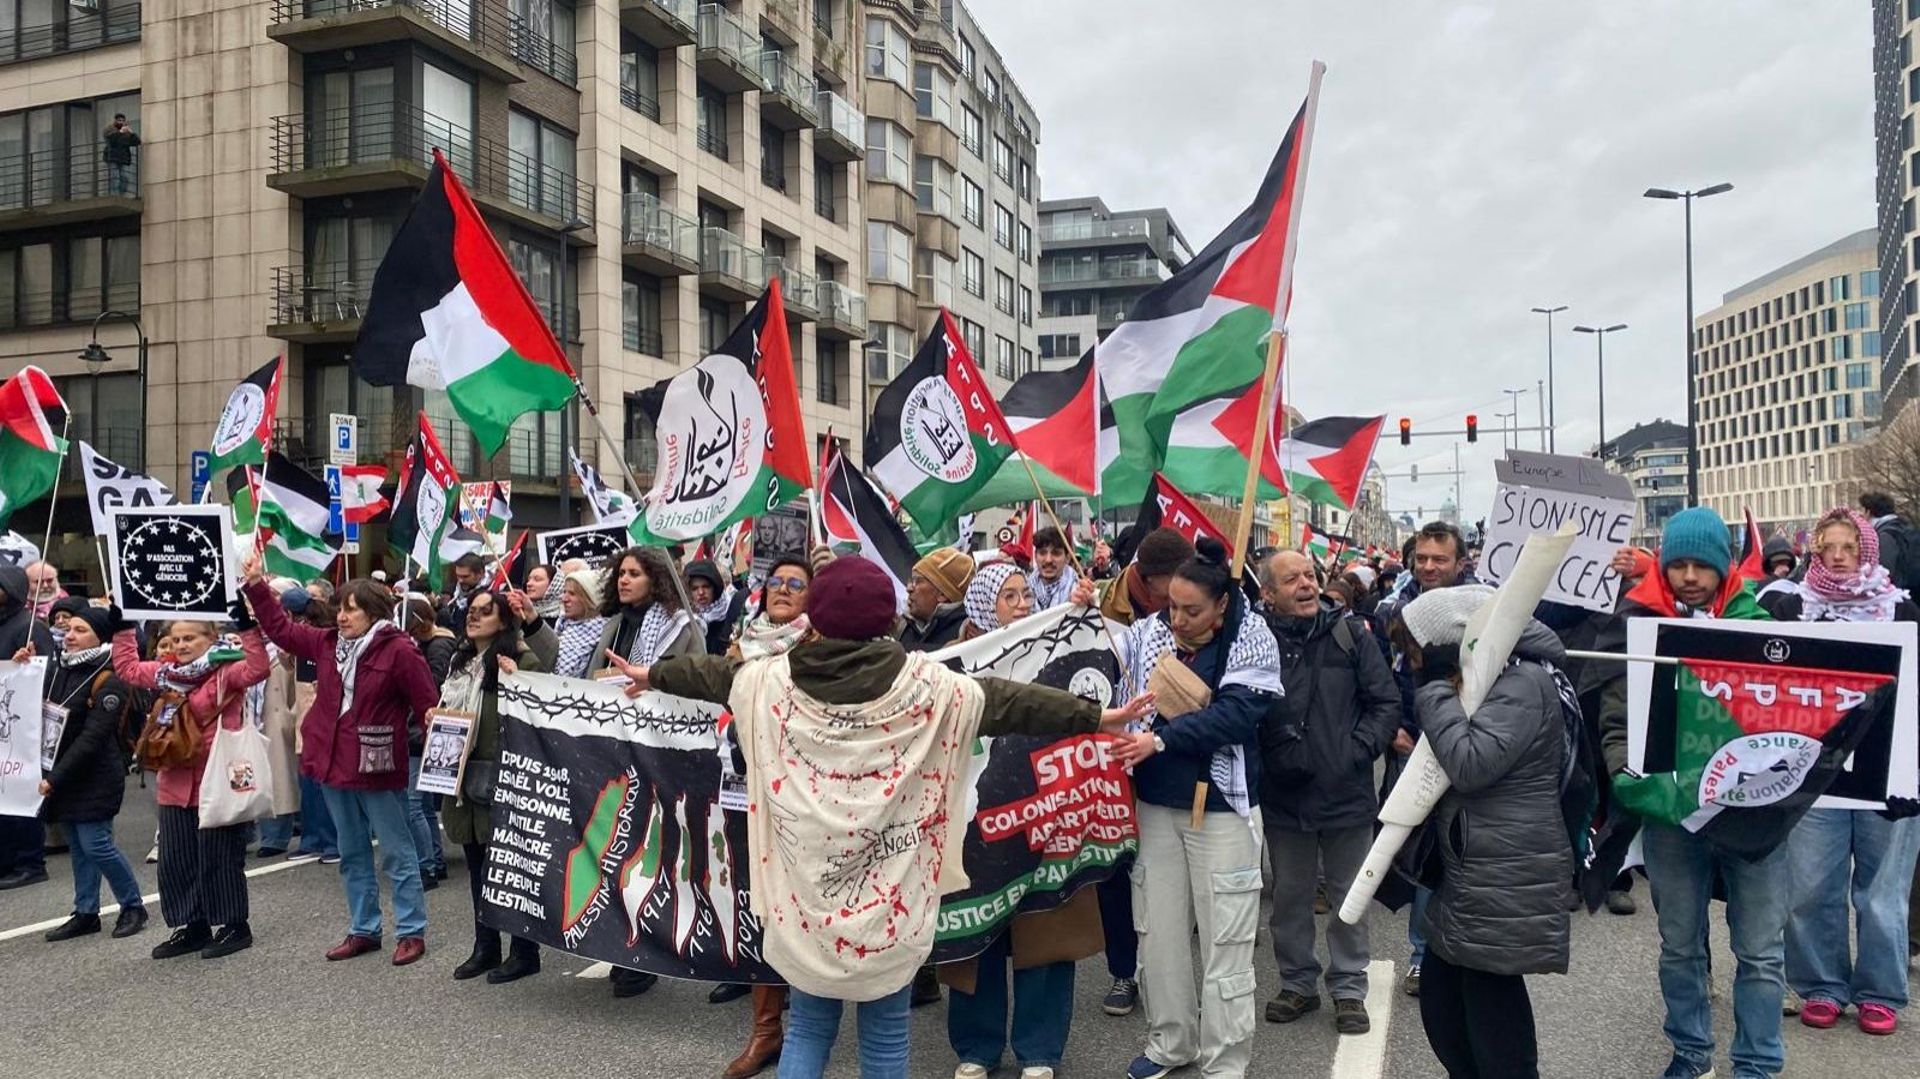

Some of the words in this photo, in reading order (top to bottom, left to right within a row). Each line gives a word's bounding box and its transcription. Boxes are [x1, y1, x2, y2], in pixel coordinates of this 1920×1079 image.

[335, 416, 352, 425] ZONE
[340, 430, 349, 446] P
[1513, 460, 1564, 483] Europe
[1497, 491, 1633, 544] SIONISME
[146, 554, 194, 563] D'ASSOCIATION
[159, 564, 174, 572] AVEC
[1488, 542, 1618, 603] CCER
[1700, 679, 1867, 712] AFPS
[1749, 736, 1809, 754] rance
[1036, 739, 1114, 786] STOP
[535, 780, 571, 804] VOLE,
[981, 777, 1122, 834] COLONISATION
[601, 765, 641, 875] HISTORIQUE
[1030, 800, 1130, 845] APARTEID
[489, 847, 547, 877] TERRORISE
[487, 867, 503, 883] LE
[504, 871, 541, 898] PEUPLE
[640, 866, 672, 934] 1947
[935, 897, 1006, 933] USTICE
[737, 889, 762, 963] 2023
